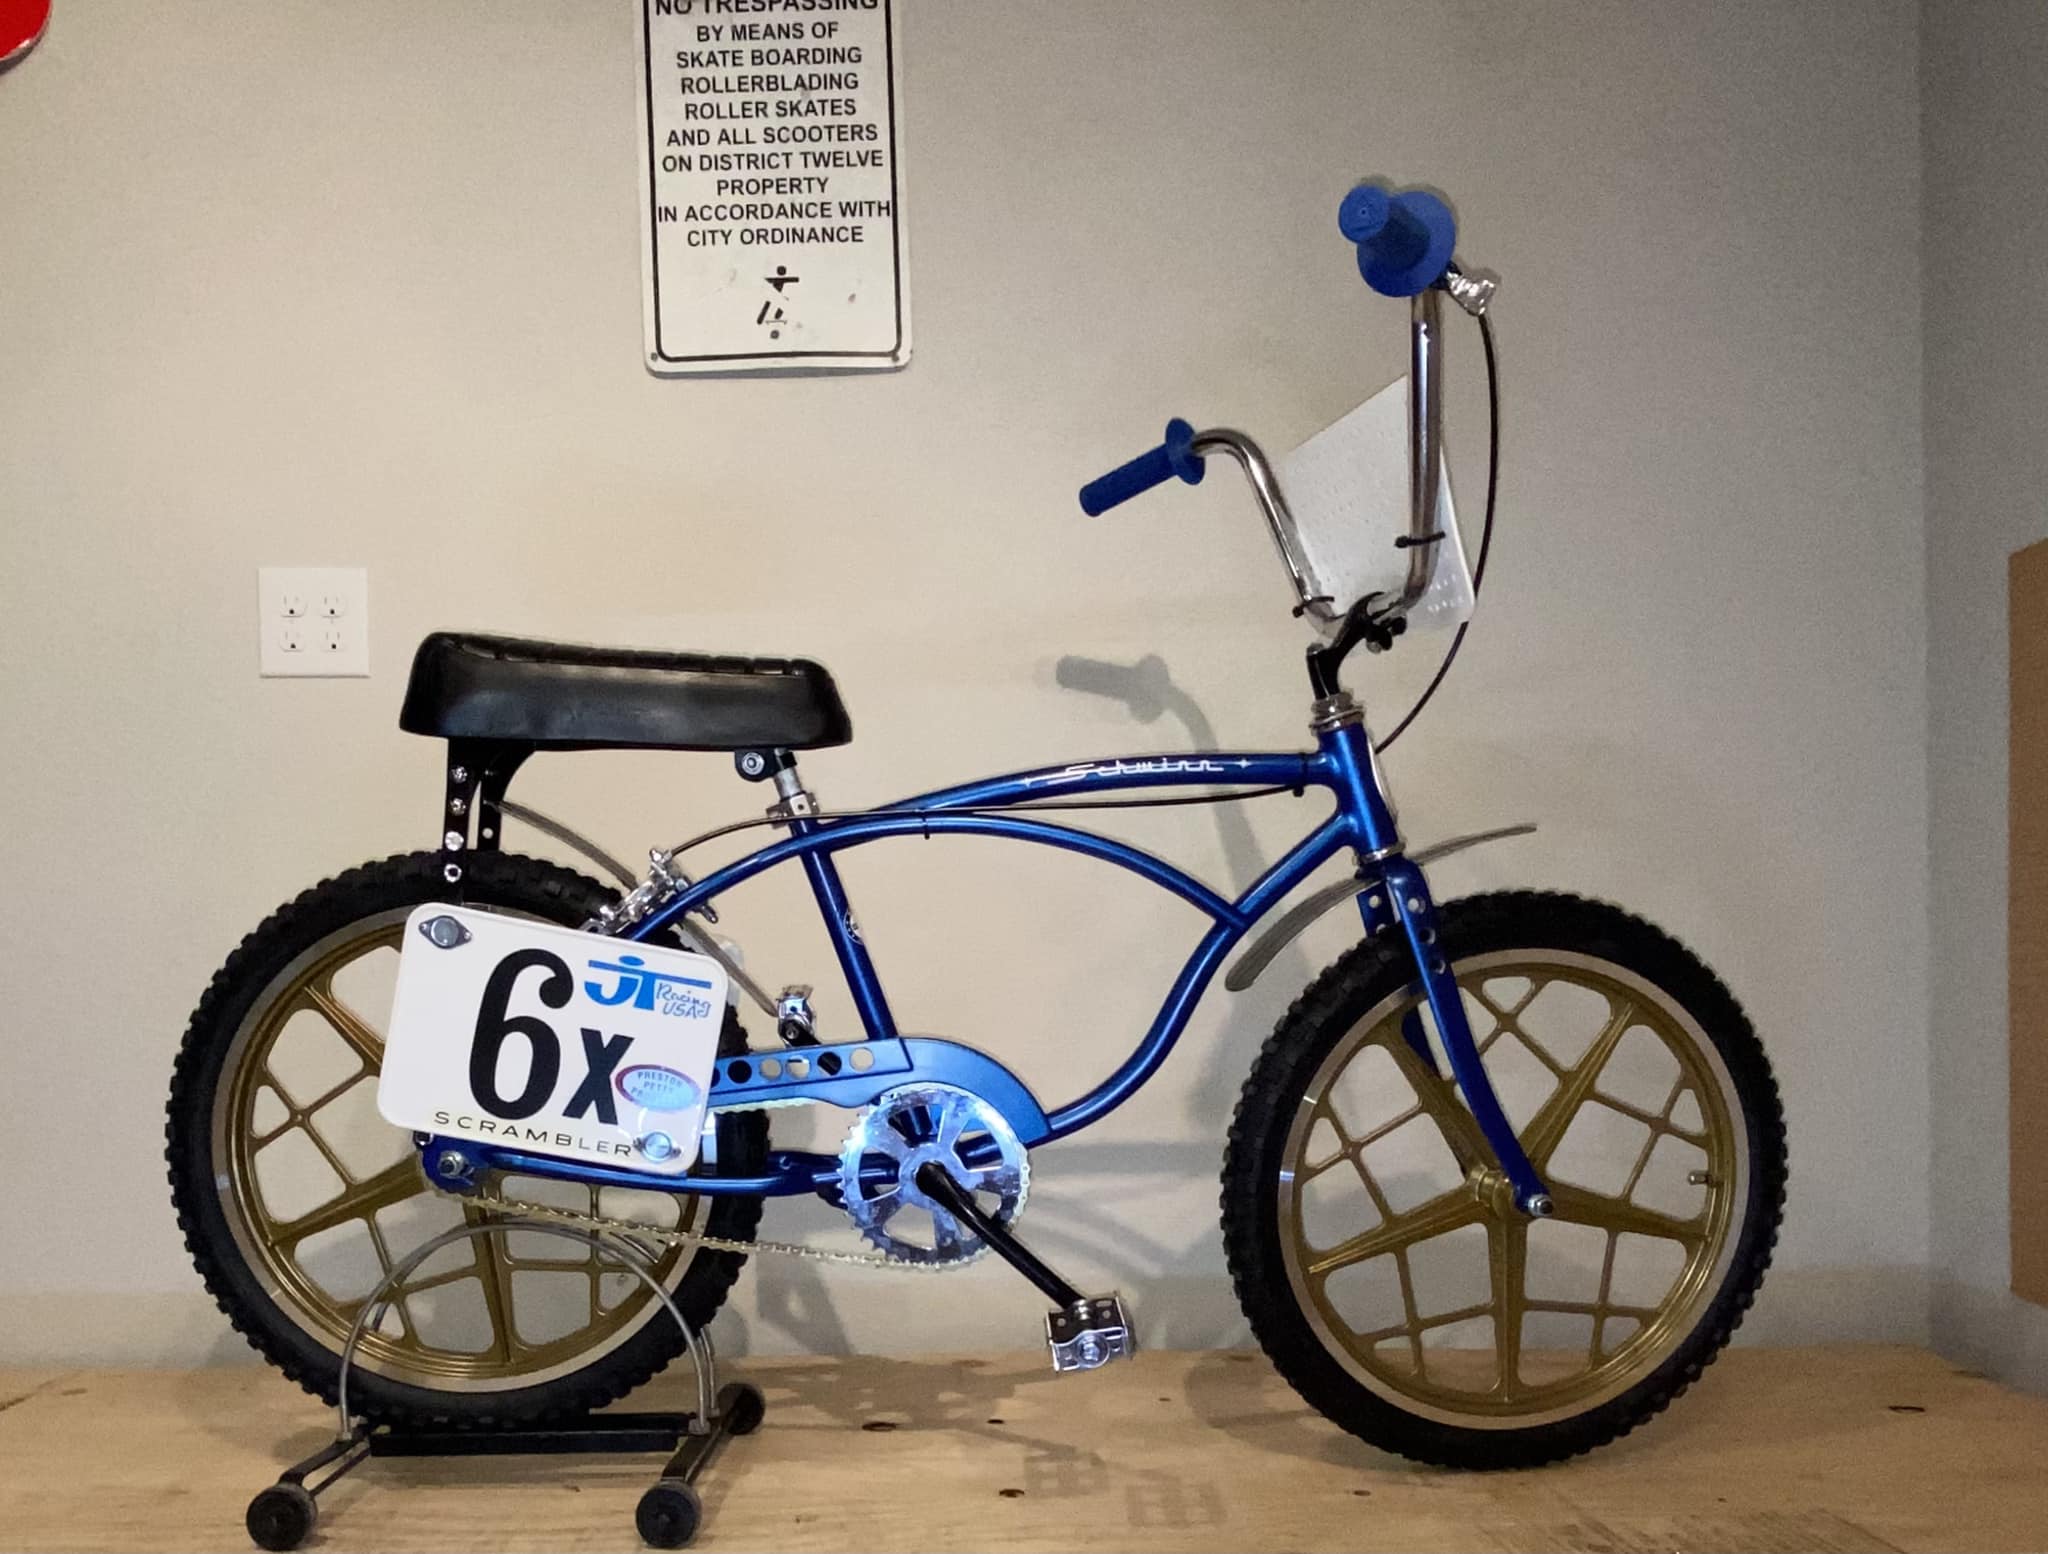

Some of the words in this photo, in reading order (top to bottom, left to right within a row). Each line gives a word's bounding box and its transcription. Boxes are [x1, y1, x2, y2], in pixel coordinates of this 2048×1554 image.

[656, 0, 692, 16] NO
[696, 25, 723, 43] BY
[730, 23, 805, 42] MEANS
[811, 21, 839, 39] OF
[676, 50, 744, 69] SKATE
[751, 47, 863, 67] BOARDING
[681, 73, 859, 95] ROLLERBLADING
[684, 101, 769, 120] ROLLER
[776, 99, 857, 118] SKATES
[667, 129, 710, 147] AND
[717, 127, 756, 145] ALL
[763, 124, 878, 144] SCOOTERS
[662, 155, 692, 173] ON
[700, 152, 793, 171] DISTRICT
[800, 150, 884, 169] TWELVE
[717, 177, 829, 197] PROPERTY
[658, 206, 677, 223] IN
[685, 201, 832, 222] ACCORDANCE
[839, 200, 890, 218] WITH
[687, 229, 732, 247] CITY
[740, 226, 864, 245] ORDINANCE
[433, 1110, 632, 1158] SCRAMBLER
